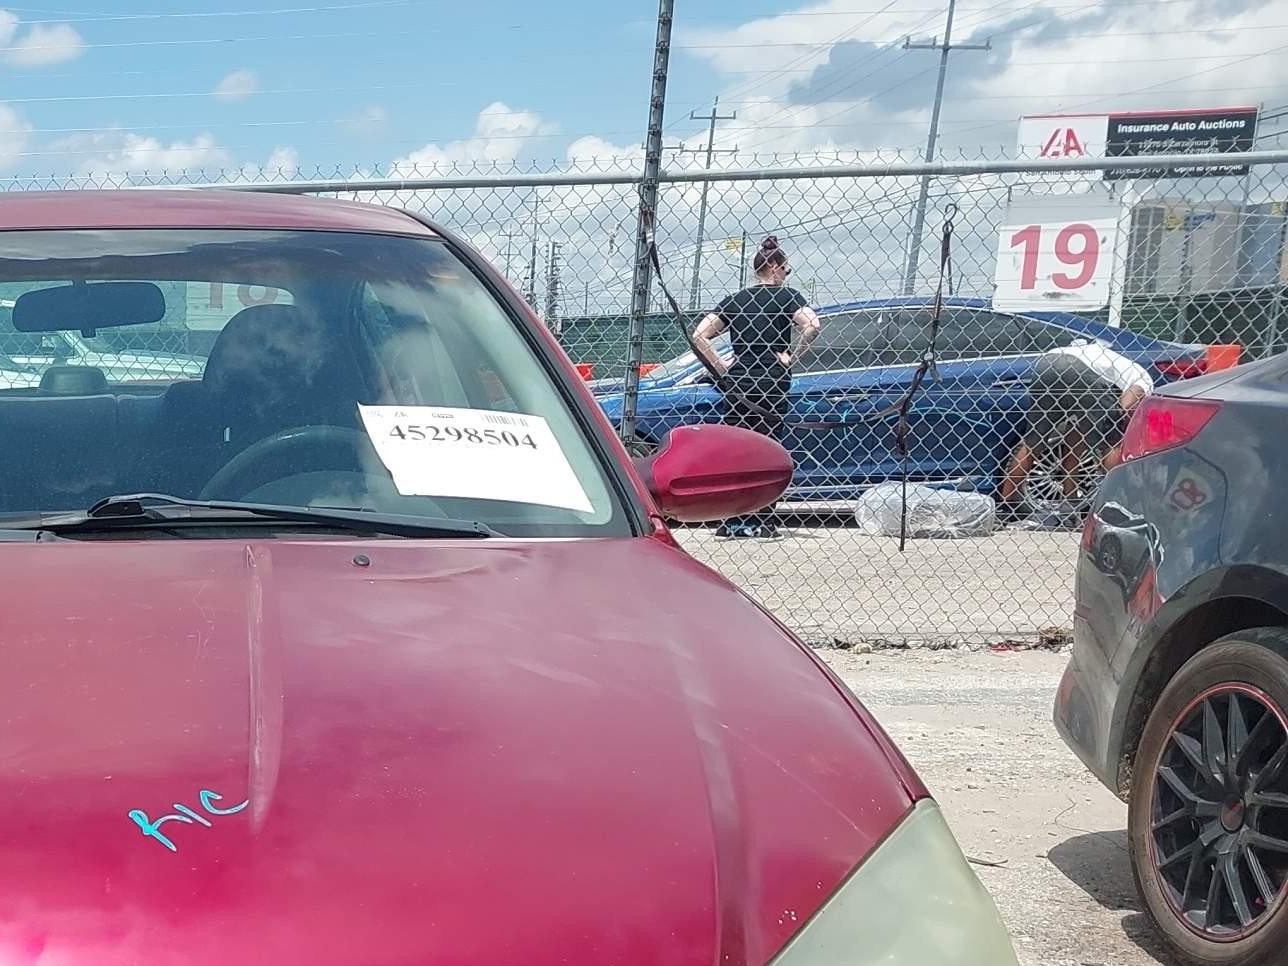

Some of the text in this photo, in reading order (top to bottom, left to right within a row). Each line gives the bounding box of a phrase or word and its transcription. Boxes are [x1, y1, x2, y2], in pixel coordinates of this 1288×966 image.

[1117, 119, 1245, 133] Insurance Auto Auctions
[1010, 223, 1099, 290] 19
[389, 424, 538, 450] 45298504
